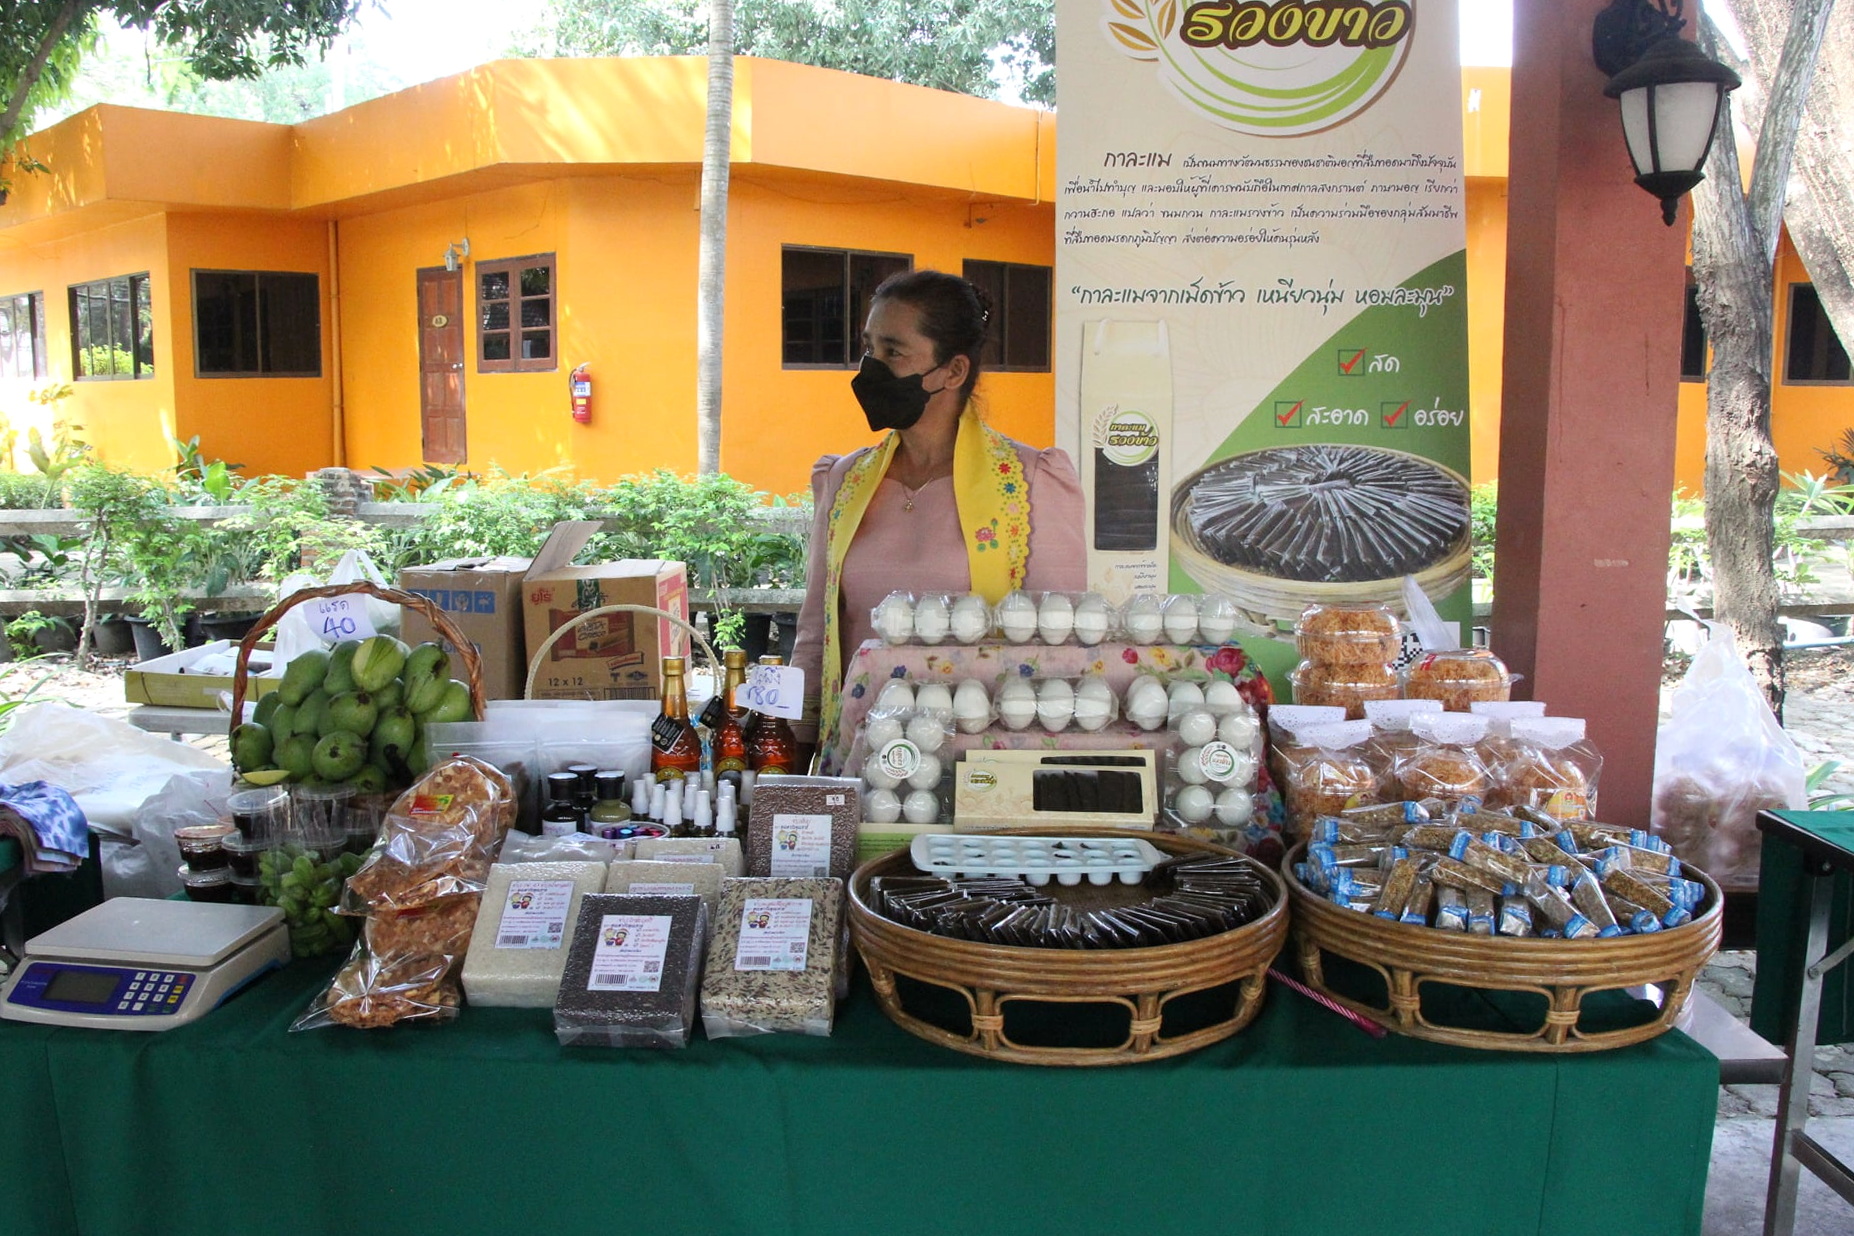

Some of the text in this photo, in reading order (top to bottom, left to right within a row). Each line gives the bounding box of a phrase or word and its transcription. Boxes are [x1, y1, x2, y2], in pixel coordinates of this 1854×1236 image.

[1103, 152, 1173, 167] กาละแม
[1370, 182, 1420, 194] ภาษามอญ
[1424, 178, 1458, 194] เรียกว่า
[1121, 202, 1155, 218] แปลว่า
[1160, 208, 1203, 218] ขนมกวน
[1209, 203, 1285, 218] กาละแมรวงข้าว
[1256, 278, 1346, 316] เหนียวนุ่ม
[1368, 353, 1401, 373] สด
[1306, 396, 1465, 426] สะอาด อร่อย
[319, 600, 350, 614] แรด
[323, 616, 357, 639] 40
[548, 677, 559, 687] 12
[572, 676, 583, 686] 12
